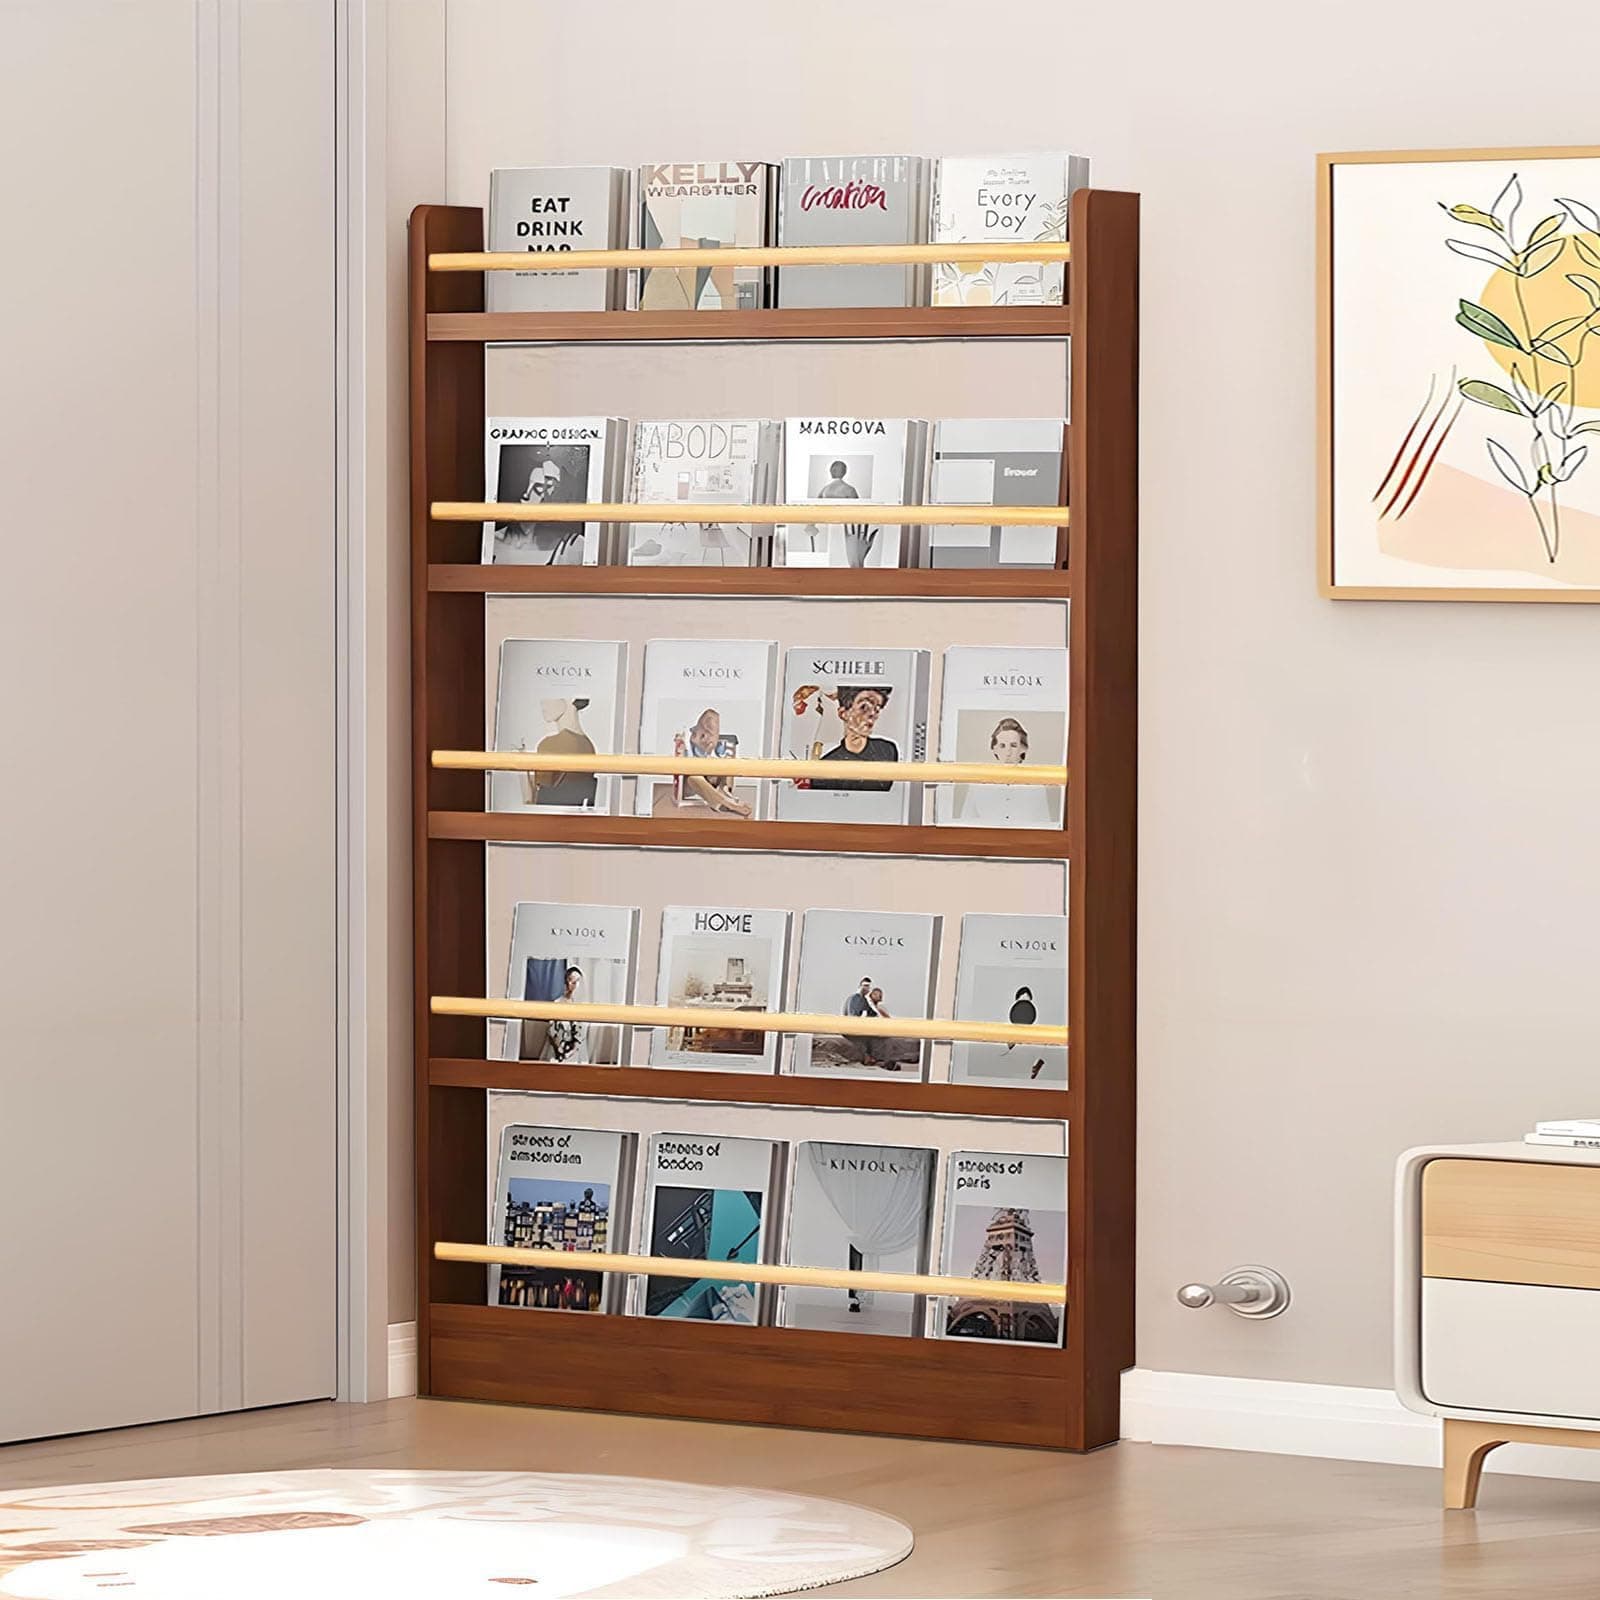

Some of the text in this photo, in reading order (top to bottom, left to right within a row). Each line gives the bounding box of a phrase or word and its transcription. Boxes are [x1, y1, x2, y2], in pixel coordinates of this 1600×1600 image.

[645, 162, 760, 185] KELLY
[532, 198, 570, 213] EAT
[517, 221, 583, 236] DRINK
[646, 423, 748, 460] ABODE
[812, 660, 885, 675] SCHIELE
[695, 912, 753, 933] HOME
[557, 1134, 572, 1148] of
[706, 1142, 721, 1157] of
[657, 1156, 703, 1171] london
[1008, 1160, 1023, 1174] of
[956, 1174, 991, 1189] paris
